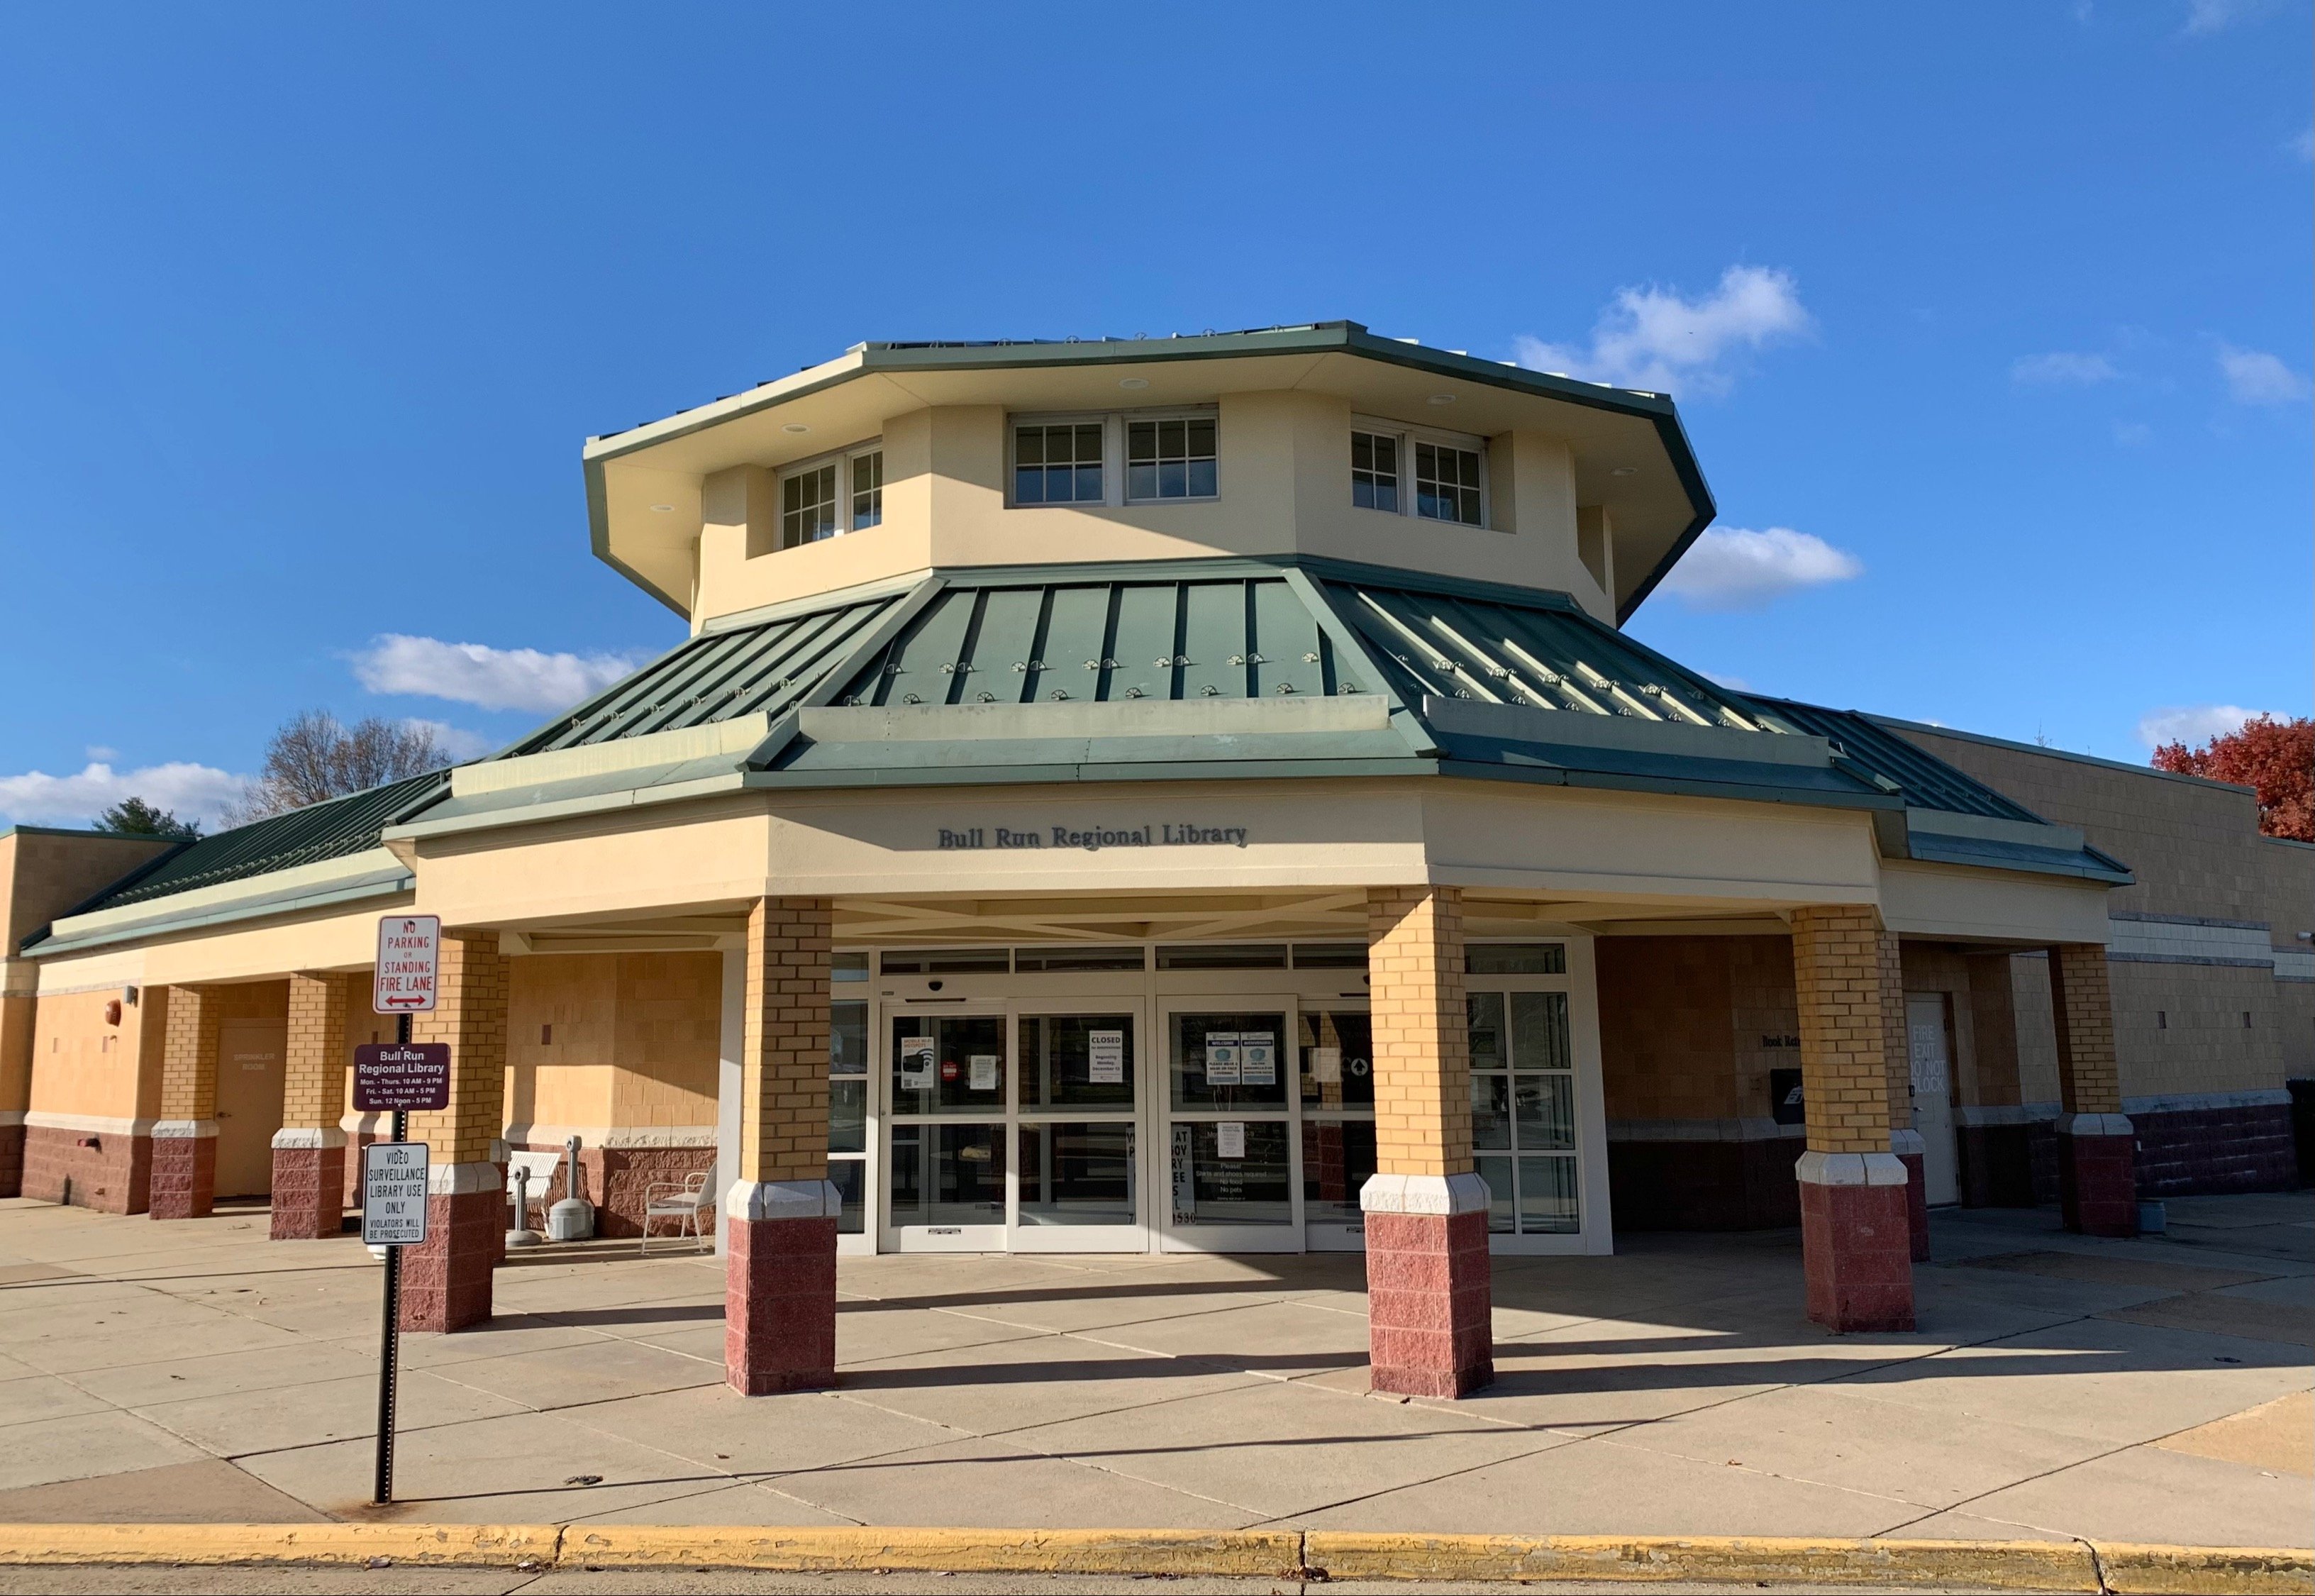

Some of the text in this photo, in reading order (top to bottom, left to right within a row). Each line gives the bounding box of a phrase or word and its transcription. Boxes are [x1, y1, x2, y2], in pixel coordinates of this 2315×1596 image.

[938, 824, 1248, 851] Bull Run Regional Library
[403, 921, 416, 933] NO
[387, 936, 430, 949] PARKING
[384, 961, 431, 974] STANDING
[380, 975, 433, 992] FIRE LANE
[1913, 1025, 1934, 1041] FIRE
[1762, 1035, 1782, 1047] Book
[233, 1053, 275, 1061] SPRINKLER
[380, 1051, 424, 1060] Bull Run
[1914, 1043, 1936, 1058] EXIT
[359, 1063, 444, 1076] Regional Library
[1926, 1059, 1946, 1076] NOT
[1911, 1076, 1945, 1093] BLOCK
[387, 1152, 409, 1165] VIDEO
[369, 1168, 425, 1181] SURVEILLANCE
[370, 1184, 421, 1197] LIBRARY USE
[386, 1202, 405, 1214] ONLY
[370, 1219, 420, 1228] VIOLATORS WILL
[370, 1229, 419, 1238] BE PROSECUTED
